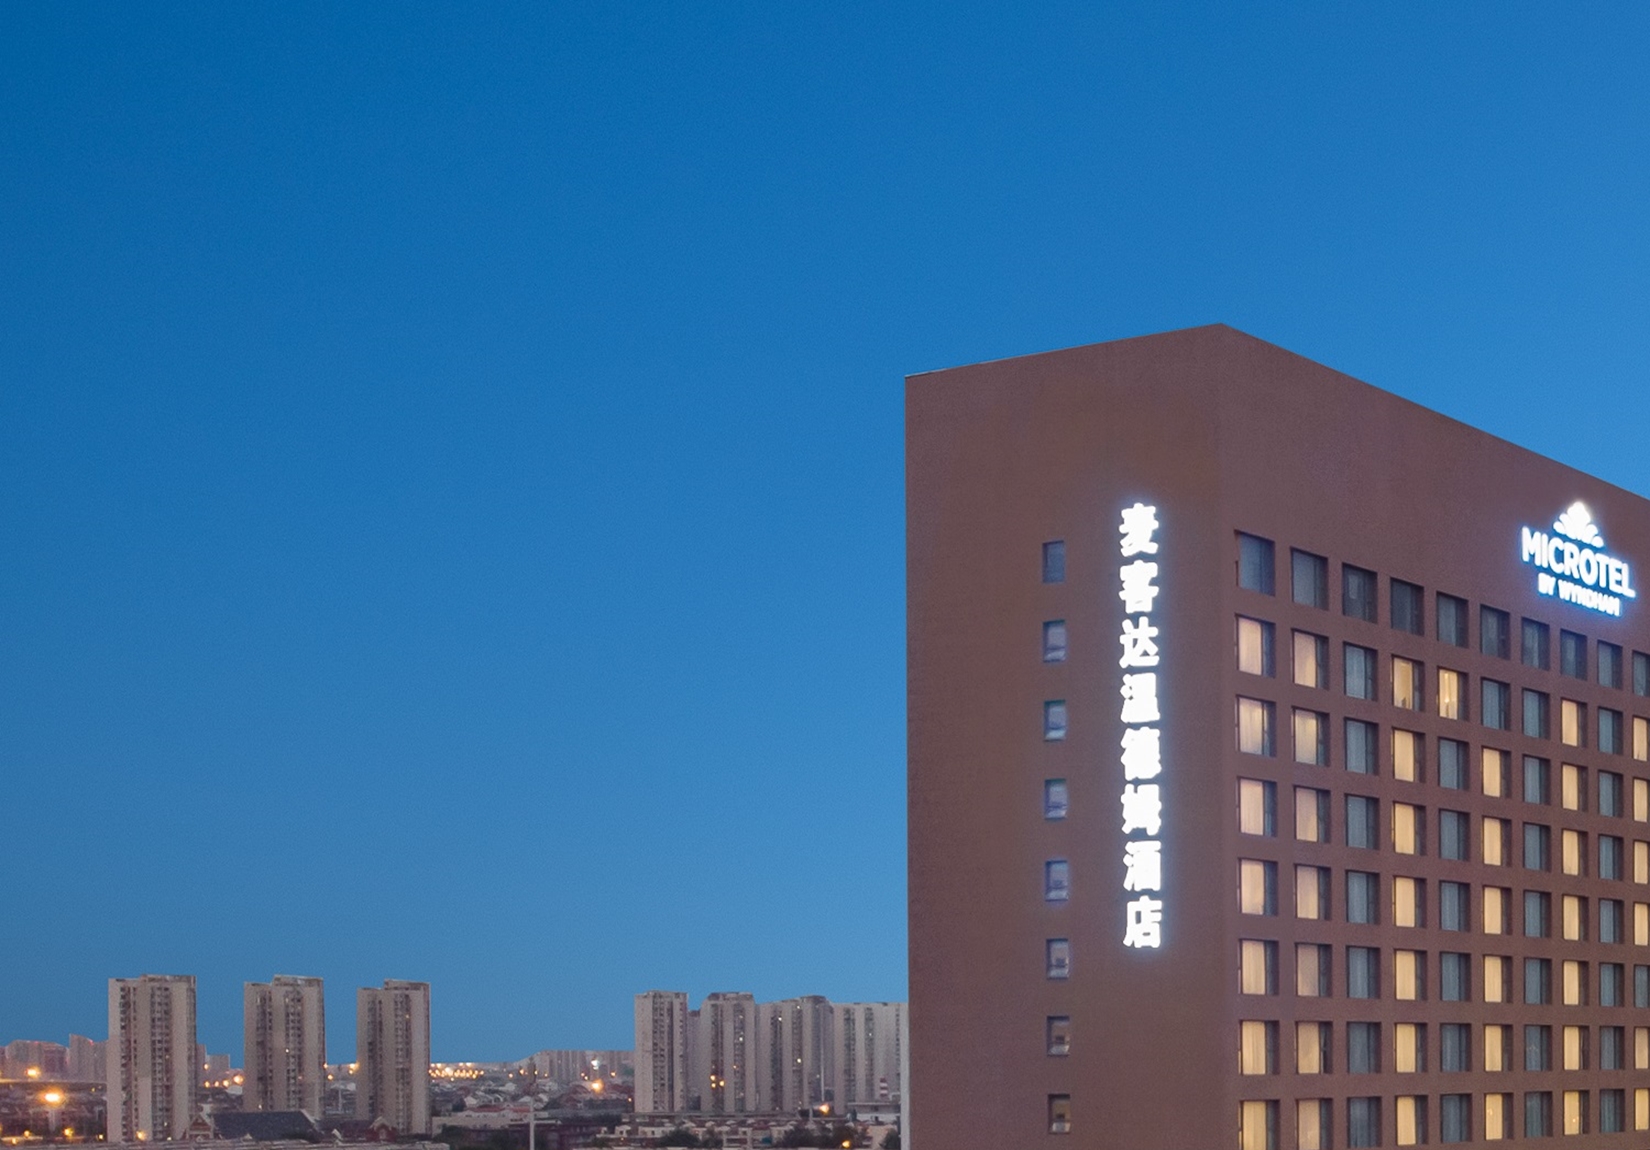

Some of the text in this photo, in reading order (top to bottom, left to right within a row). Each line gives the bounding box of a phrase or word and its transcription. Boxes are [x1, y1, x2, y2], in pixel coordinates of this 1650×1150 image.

[1521, 525, 1636, 598] MICROTEL
[1537, 572, 1621, 617] BY WYNDHAM
